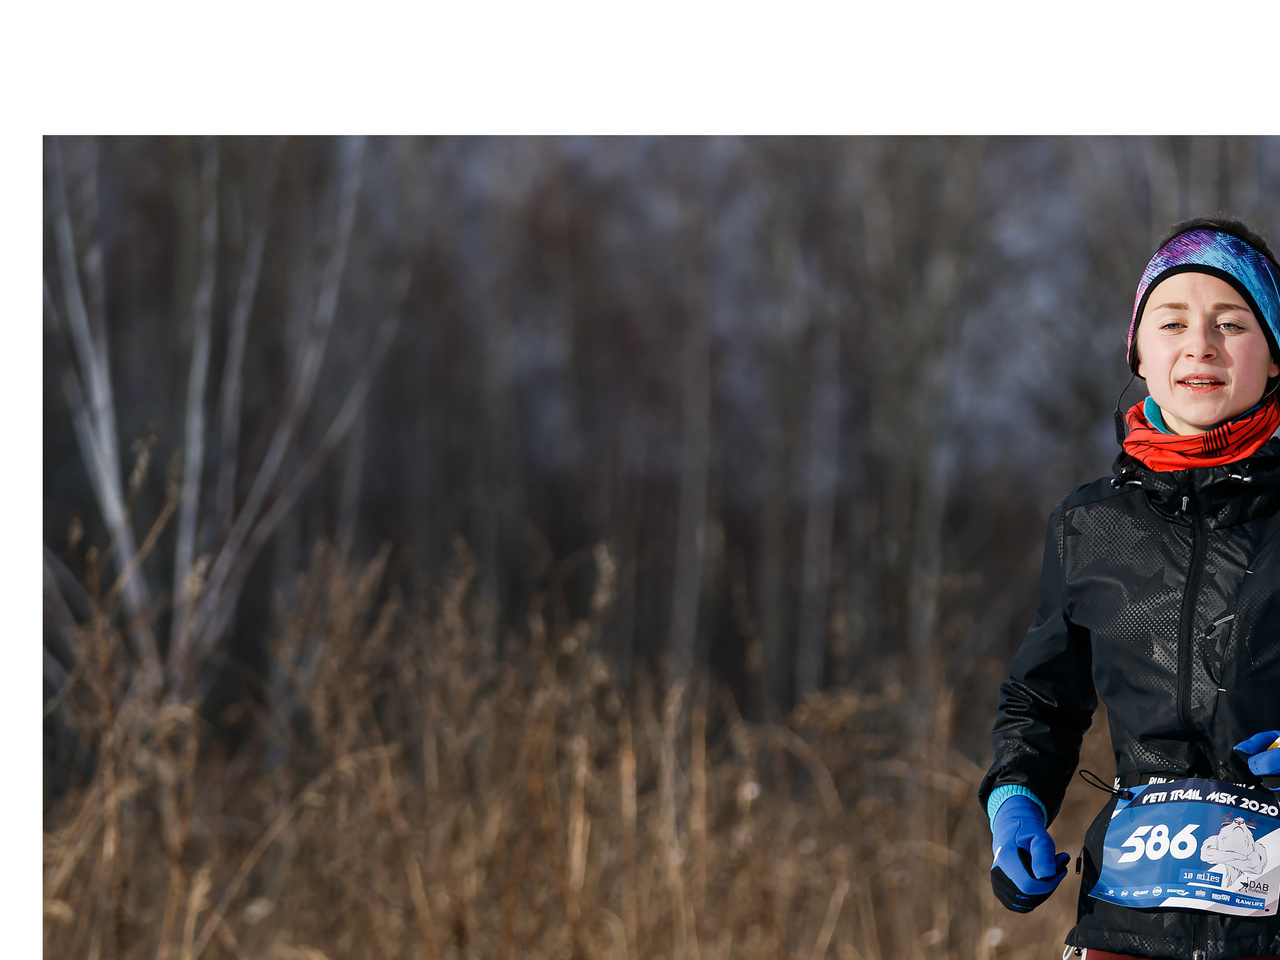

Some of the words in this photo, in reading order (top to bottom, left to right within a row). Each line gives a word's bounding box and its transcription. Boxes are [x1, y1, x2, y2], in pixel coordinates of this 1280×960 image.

[1142, 791, 1168, 805] YETI
[1170, 788, 1202, 801] TRAIL
[1206, 791, 1238, 805] MSK
[1239, 797, 1279, 816] 2020
[1117, 824, 1200, 864] 586
[1196, 872, 1220, 883] miles
[1249, 880, 1269, 892] DAB
